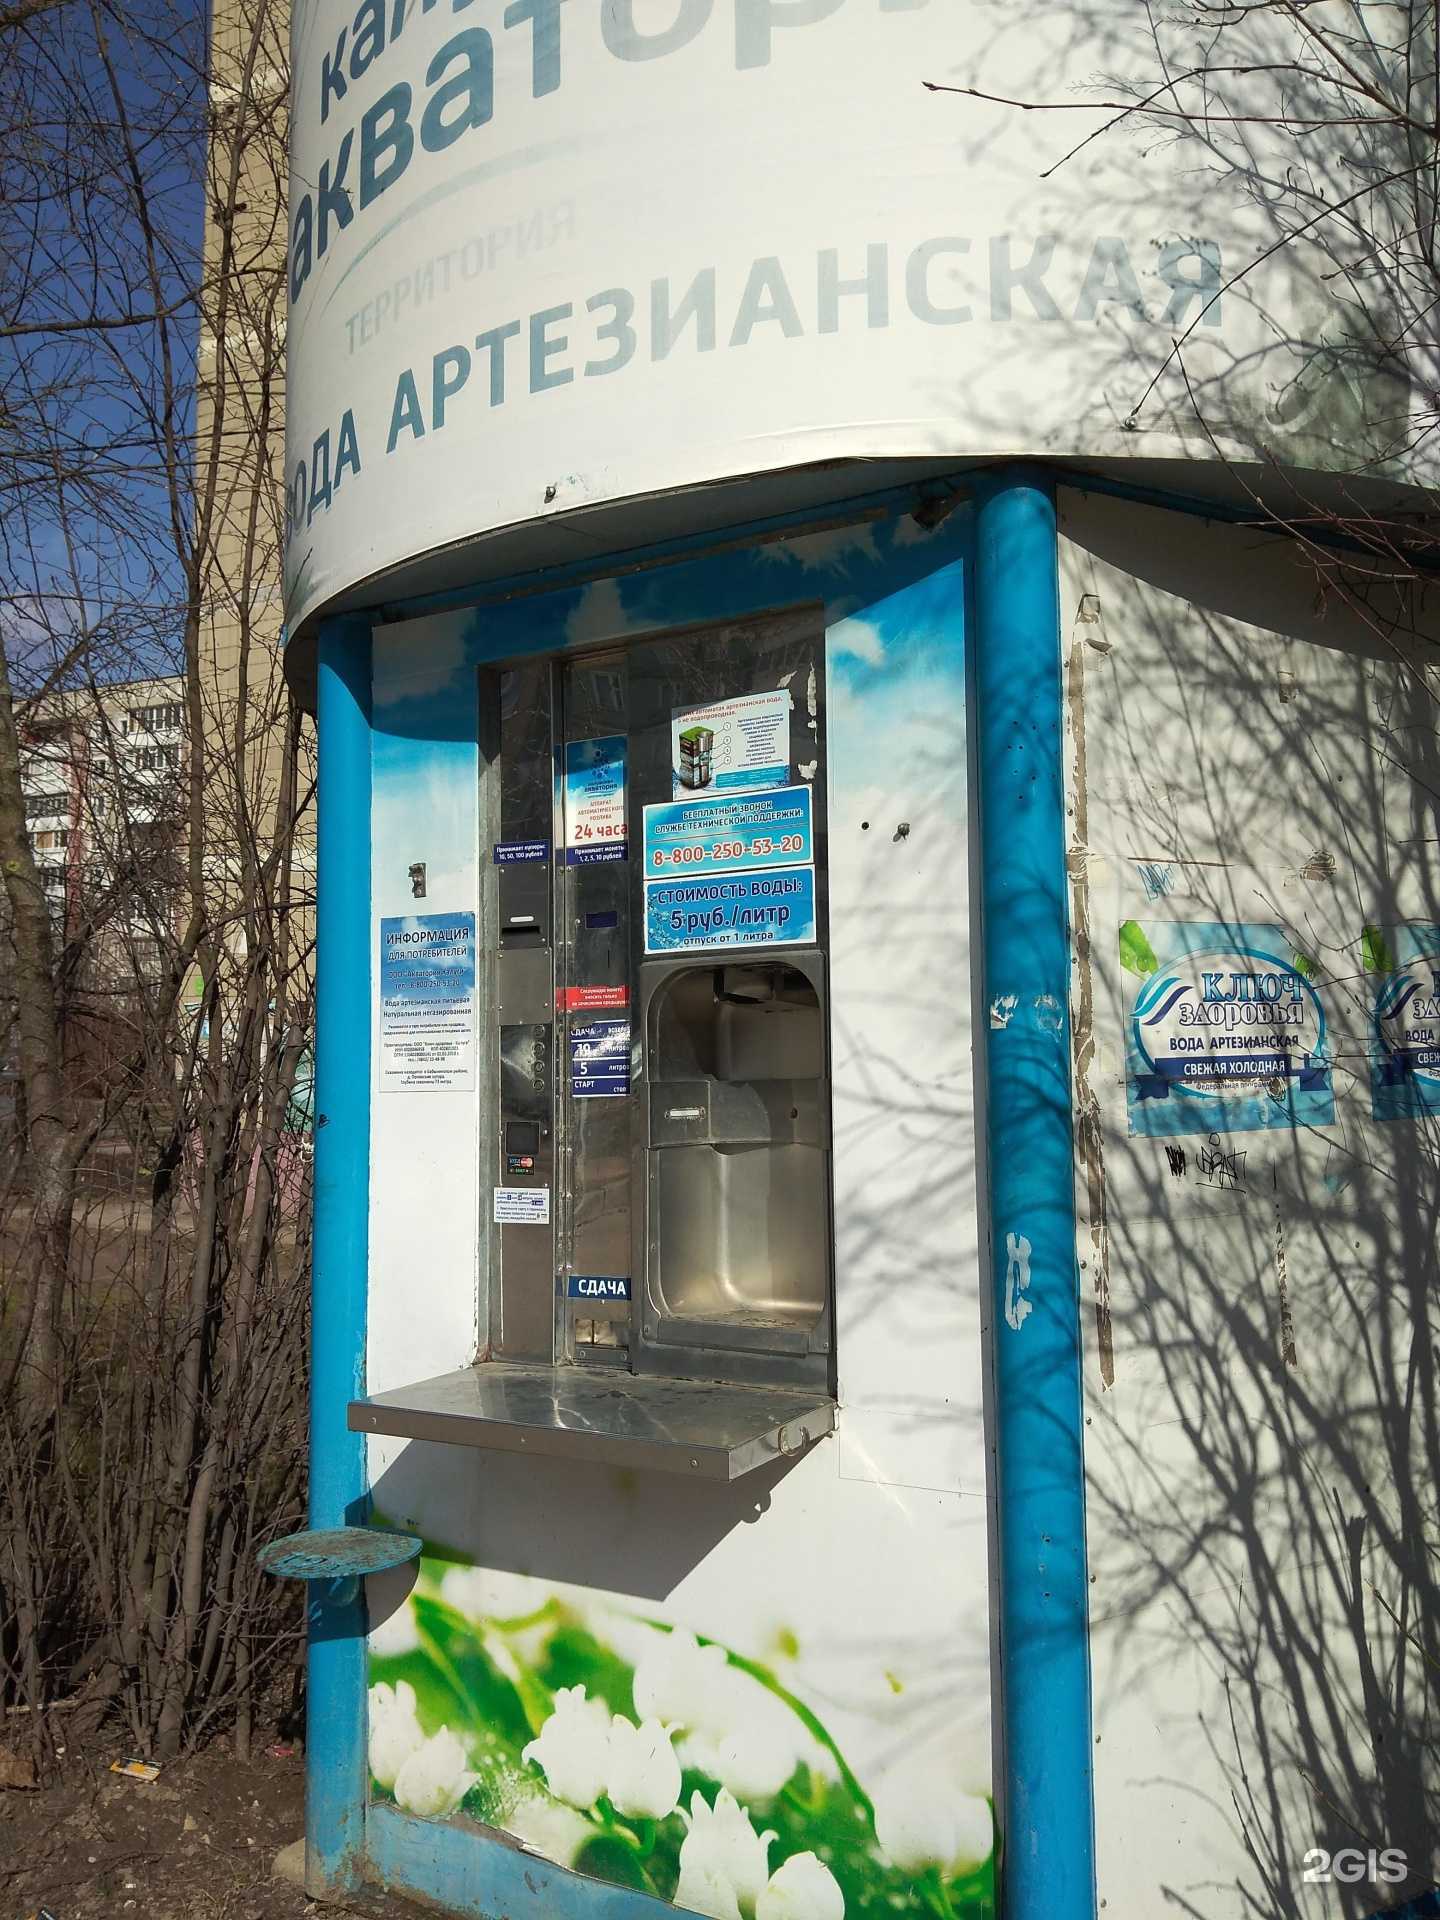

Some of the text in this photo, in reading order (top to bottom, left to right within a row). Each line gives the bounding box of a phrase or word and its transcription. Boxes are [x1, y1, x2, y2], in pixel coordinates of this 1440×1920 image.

[345, 198, 577, 356] ТЕРРИТОРИЯ
[386, 235, 1222, 455] АРТЕЗИАНСКАЯ
[684, 802, 773, 820] БЕСПЛАТНЫЙ ЗВОНОК
[575, 823, 629, 840] 24 часа
[656, 822, 687, 834] СЛУЖБЕ
[688, 814, 747, 830] ТЕХНИЧЕСКОЙ
[653, 835, 803, 866] 8-800-250-53-20
[658, 878, 803, 904] СТОИМОСТЬ ВОДЫ:
[671, 905, 790, 933] 5 руб./литр
[386, 928, 470, 944] ИНФОРМАЦИЯ
[684, 936, 717, 946] отпуск
[719, 935, 731, 943] от
[742, 931, 774, 942] литра
[388, 945, 467, 961] ДЛЯ ПОТРЕБИТЕЛЕЙ
[1201, 972, 1304, 1003] КЛЮЧ
[385, 1000, 400, 1008] Вода
[401, 999, 441, 1007] артезианская
[383, 1008, 472, 1019] Натуральная негазированная
[1170, 1035, 1299, 1051] ВОДА АРТЕЗИАНСКАЯ
[1405, 1029, 1435, 1041] ВОДА
[580, 1062, 630, 1075] 5 литров
[1184, 1060, 1286, 1076] СВЕЖАЯ ХОЛОДНАЯ
[574, 1080, 595, 1088] СТАРТ
[578, 1278, 626, 1296] СДАЧА
